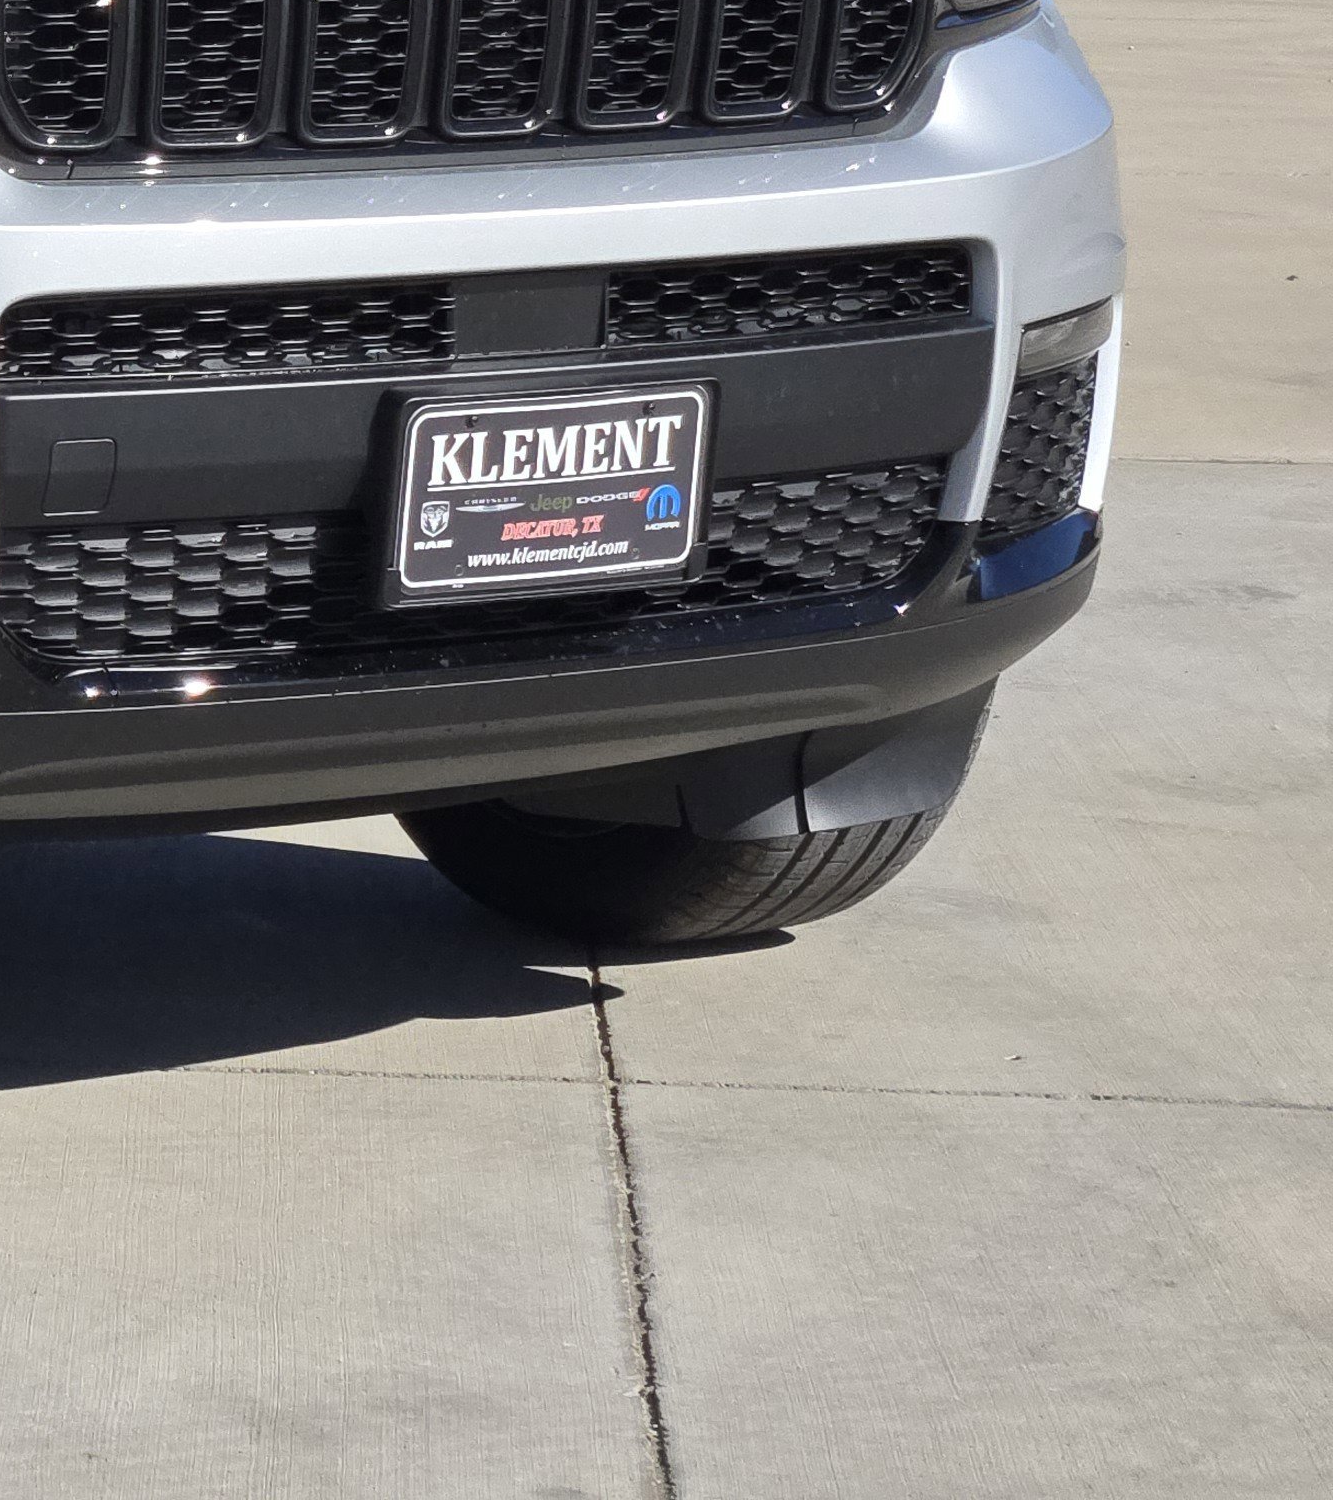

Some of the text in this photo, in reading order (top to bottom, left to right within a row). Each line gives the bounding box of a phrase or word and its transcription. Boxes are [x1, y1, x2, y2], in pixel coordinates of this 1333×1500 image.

[427, 414, 683, 488] KLEMENT
[529, 493, 573, 513] Jeep
[576, 489, 641, 505] DODGE
[500, 514, 605, 542] DECATUR, TX
[413, 538, 454, 551] RAM
[467, 539, 629, 568] www.klementcjd.com
